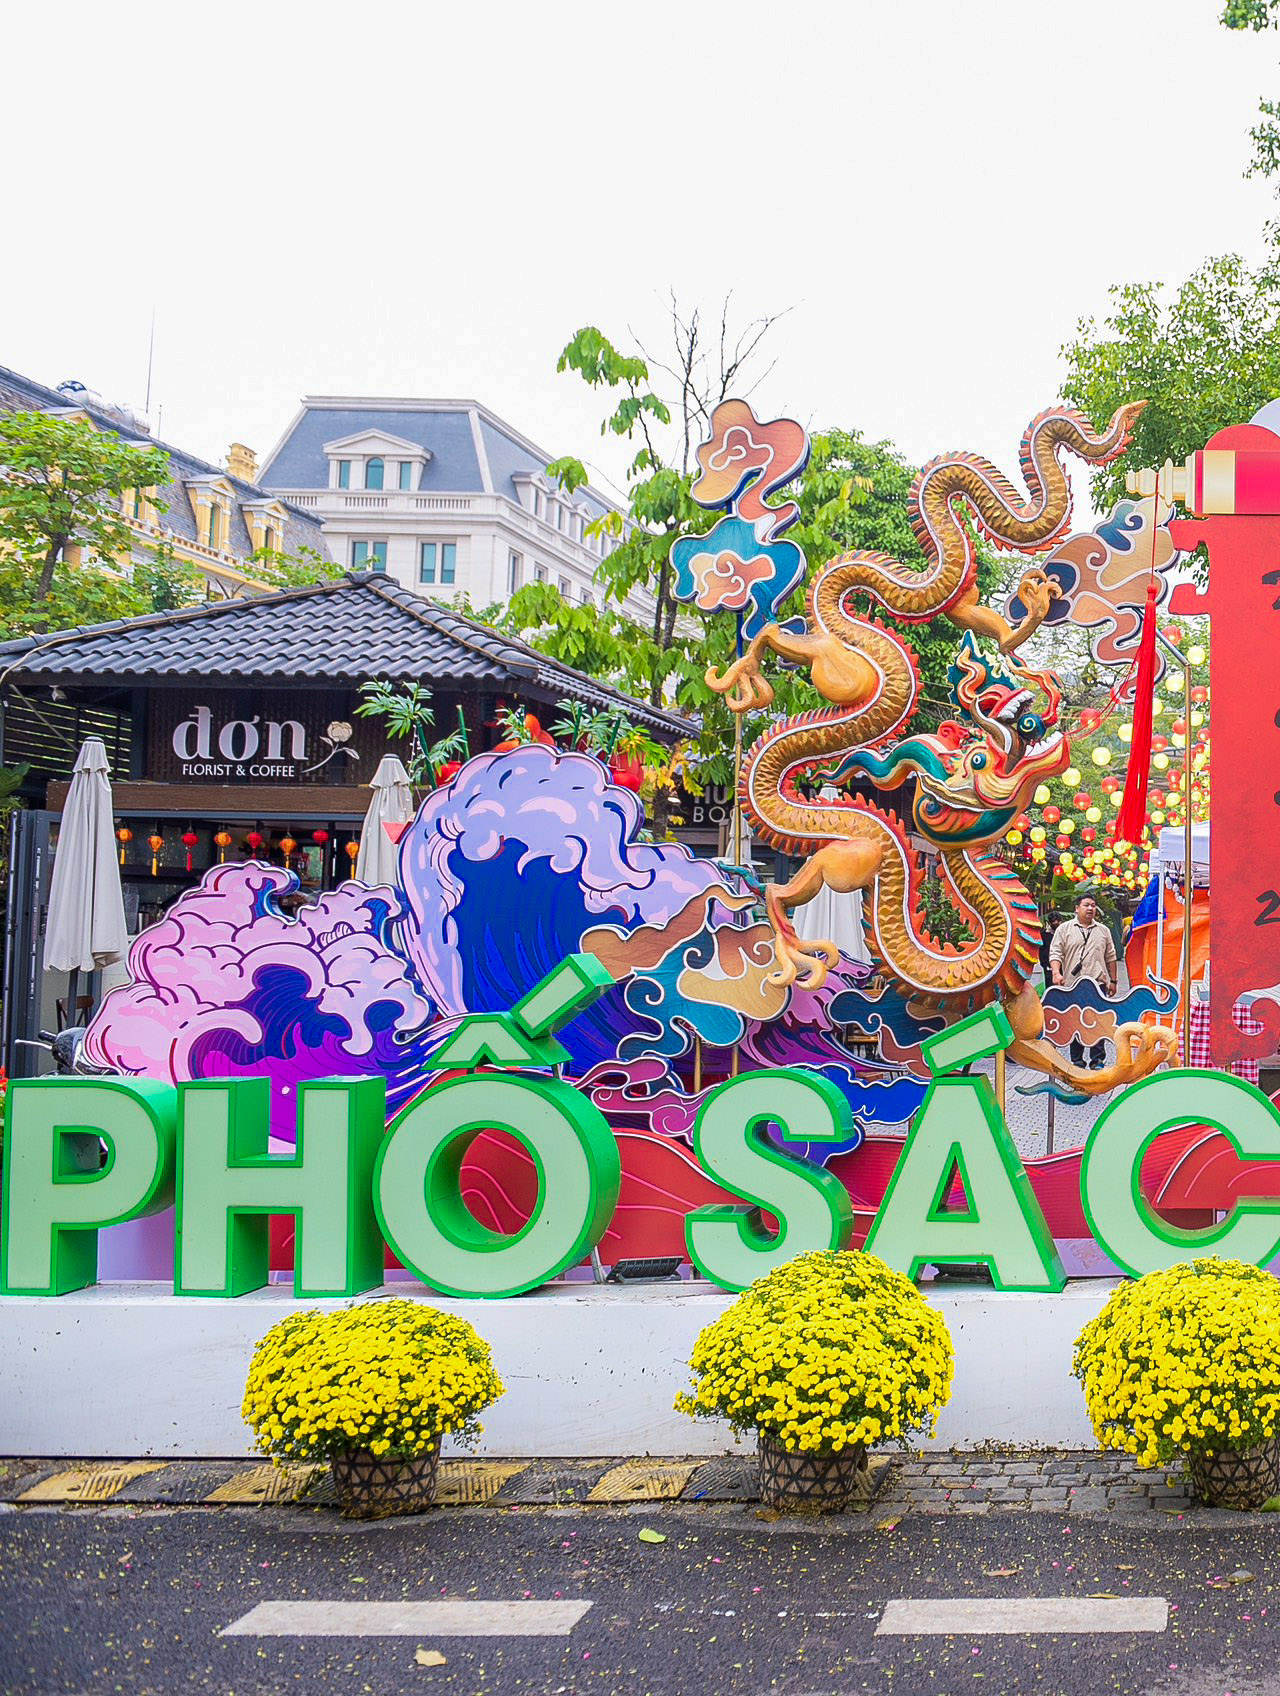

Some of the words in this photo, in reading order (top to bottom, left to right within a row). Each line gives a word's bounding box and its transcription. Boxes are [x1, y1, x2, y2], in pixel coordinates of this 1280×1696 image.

[172, 705, 309, 761] đơn
[182, 763, 233, 776] FLORIST
[235, 764, 246, 777] &
[249, 764, 295, 777] COFFEE
[0, 952, 621, 1299] PHỐ
